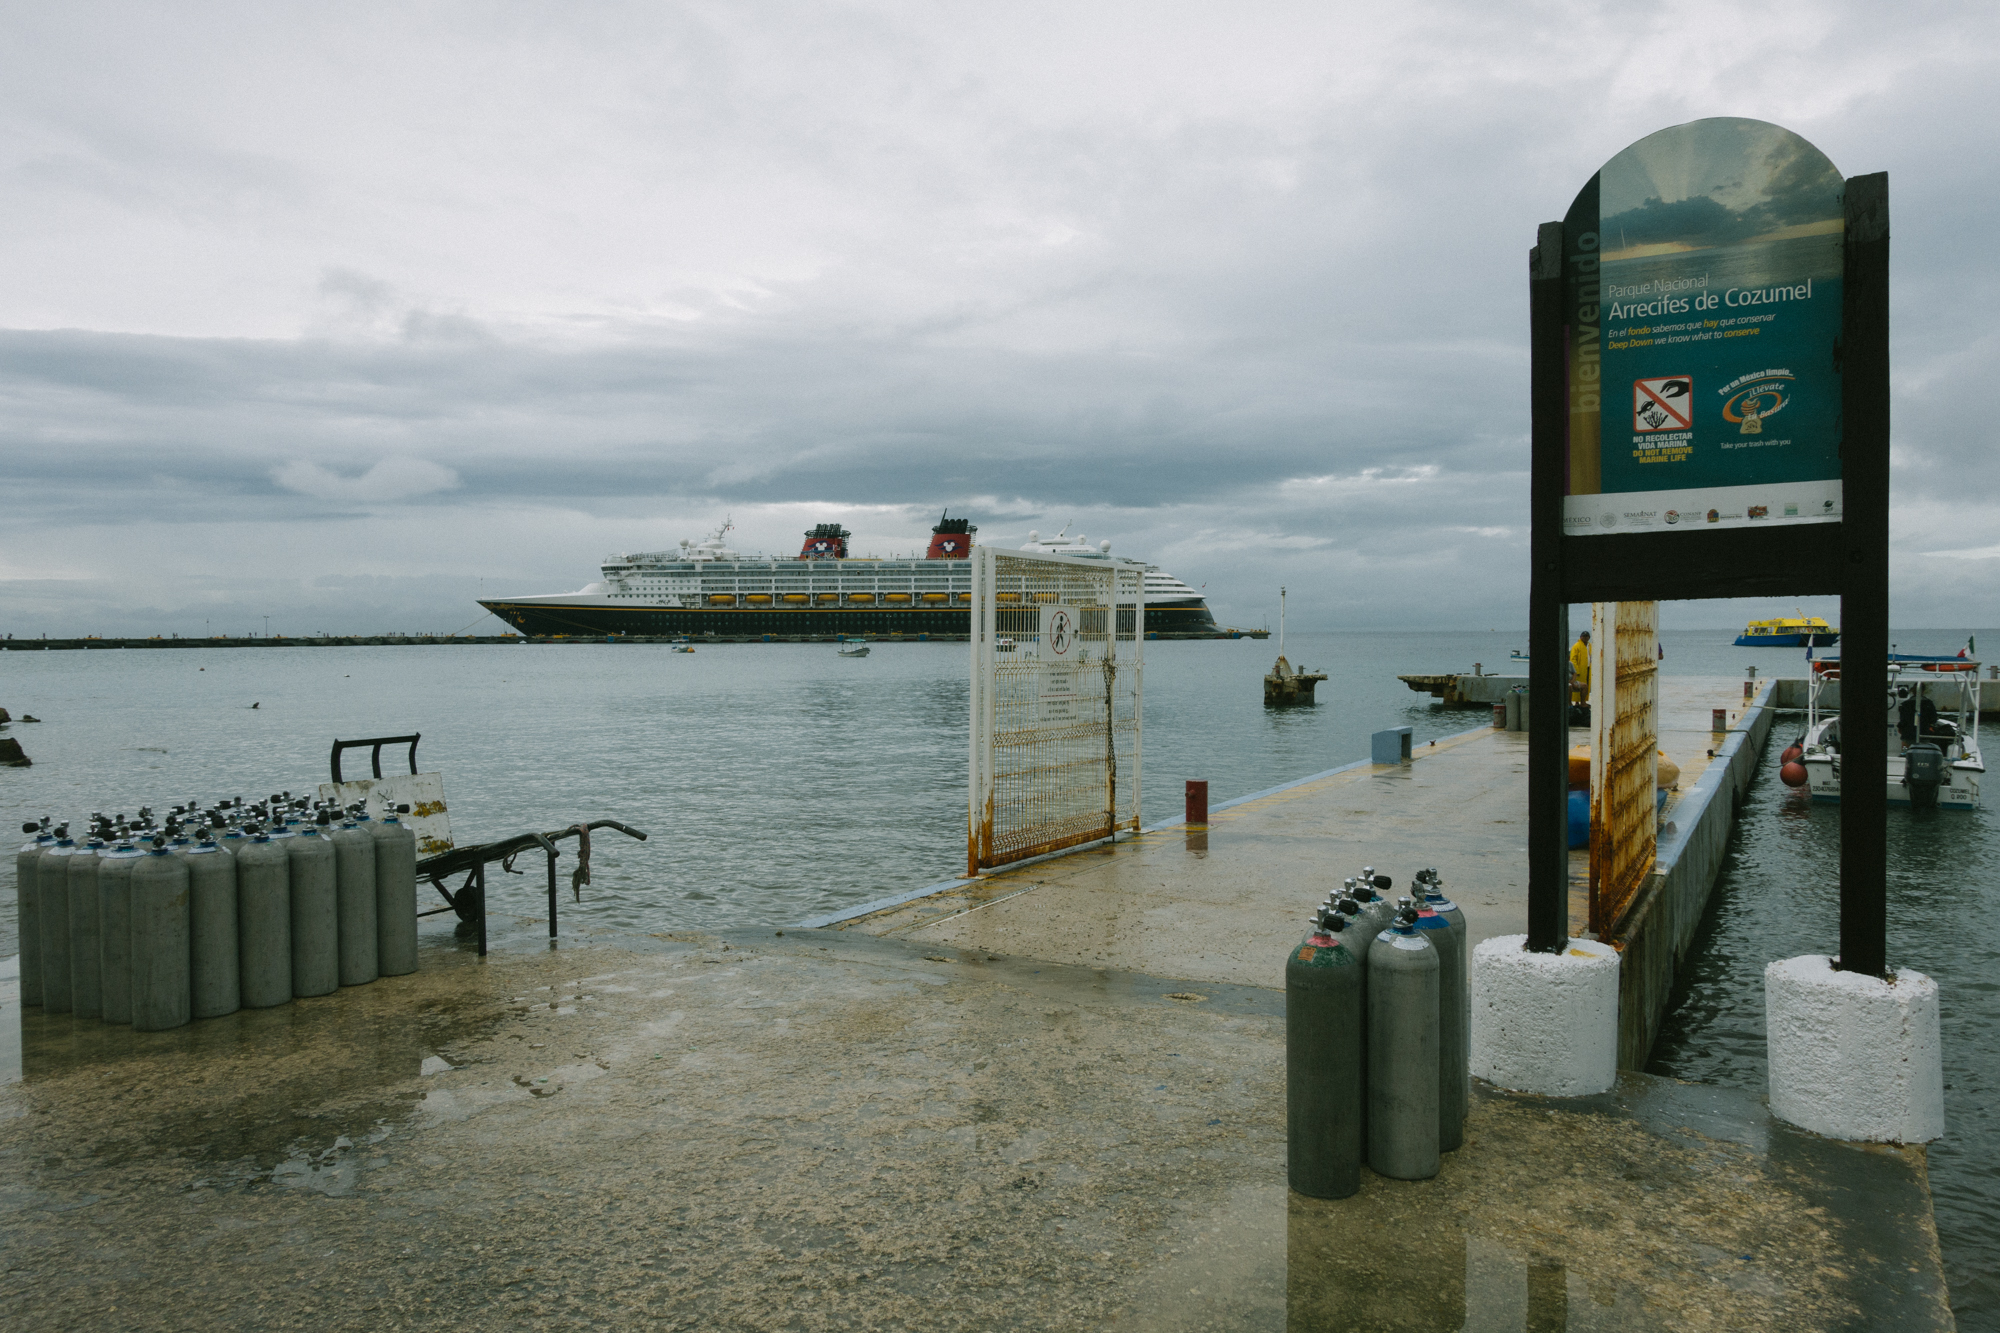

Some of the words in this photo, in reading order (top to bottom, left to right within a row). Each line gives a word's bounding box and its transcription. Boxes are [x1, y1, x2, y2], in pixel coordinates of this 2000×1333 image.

[1608, 283, 1650, 299] Parque
[1654, 273, 1709, 293] Nacional
[1608, 295, 1689, 320] Arrecifes
[1695, 291, 1719, 311] de
[1725, 278, 1812, 307] Cozumel
[1570, 231, 1600, 414] bienvenido
[1608, 329, 1618, 338] En
[1619, 328, 1627, 337] el
[1628, 325, 1651, 335] fondo
[1652, 322, 1686, 334] sabemos
[1686, 320, 1702, 332] que
[1703, 318, 1719, 329] hay
[1720, 317, 1736, 327] que
[1736, 313, 1776, 324] conservar
[1608, 340, 1628, 350] Deep
[1630, 338, 1653, 348] Down
[1654, 336, 1666, 345] we
[1667, 334, 1690, 344] know
[1691, 331, 1712, 342] what
[1714, 330, 1722, 339] to
[1723, 327, 1760, 338] conserve
[1718, 384, 1730, 395] Por
[1730, 380, 1740, 388] un
[1739, 371, 1765, 384] México
[1645, 432, 1692, 442] RECOLECTAR
[1657, 440, 1688, 448] MARINA
[1633, 449, 1643, 457] DO
[1645, 448, 1660, 456] NOT
[1639, 455, 1668, 463] MARINE
